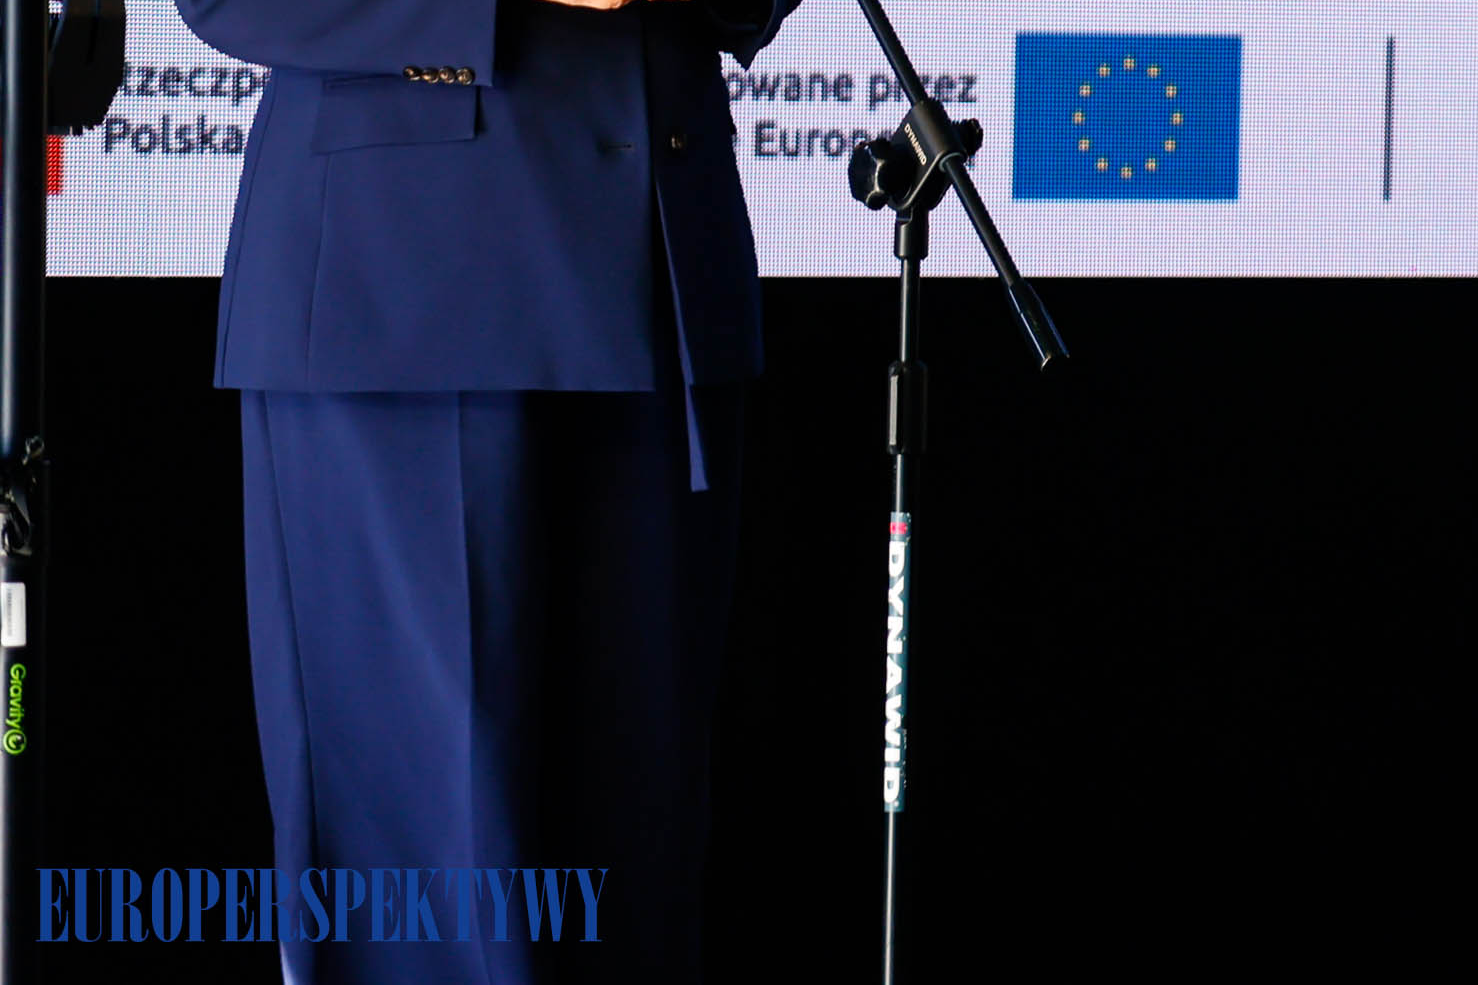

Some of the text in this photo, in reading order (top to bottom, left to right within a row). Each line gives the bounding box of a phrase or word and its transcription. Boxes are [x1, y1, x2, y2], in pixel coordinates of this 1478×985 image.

[123, 66, 271, 106] zeczp
[105, 113, 243, 153] Polska
[904, 123, 927, 166] DYNAWID
[884, 540, 905, 803] DYNAWID
[5, 663, 27, 730] Gravity
